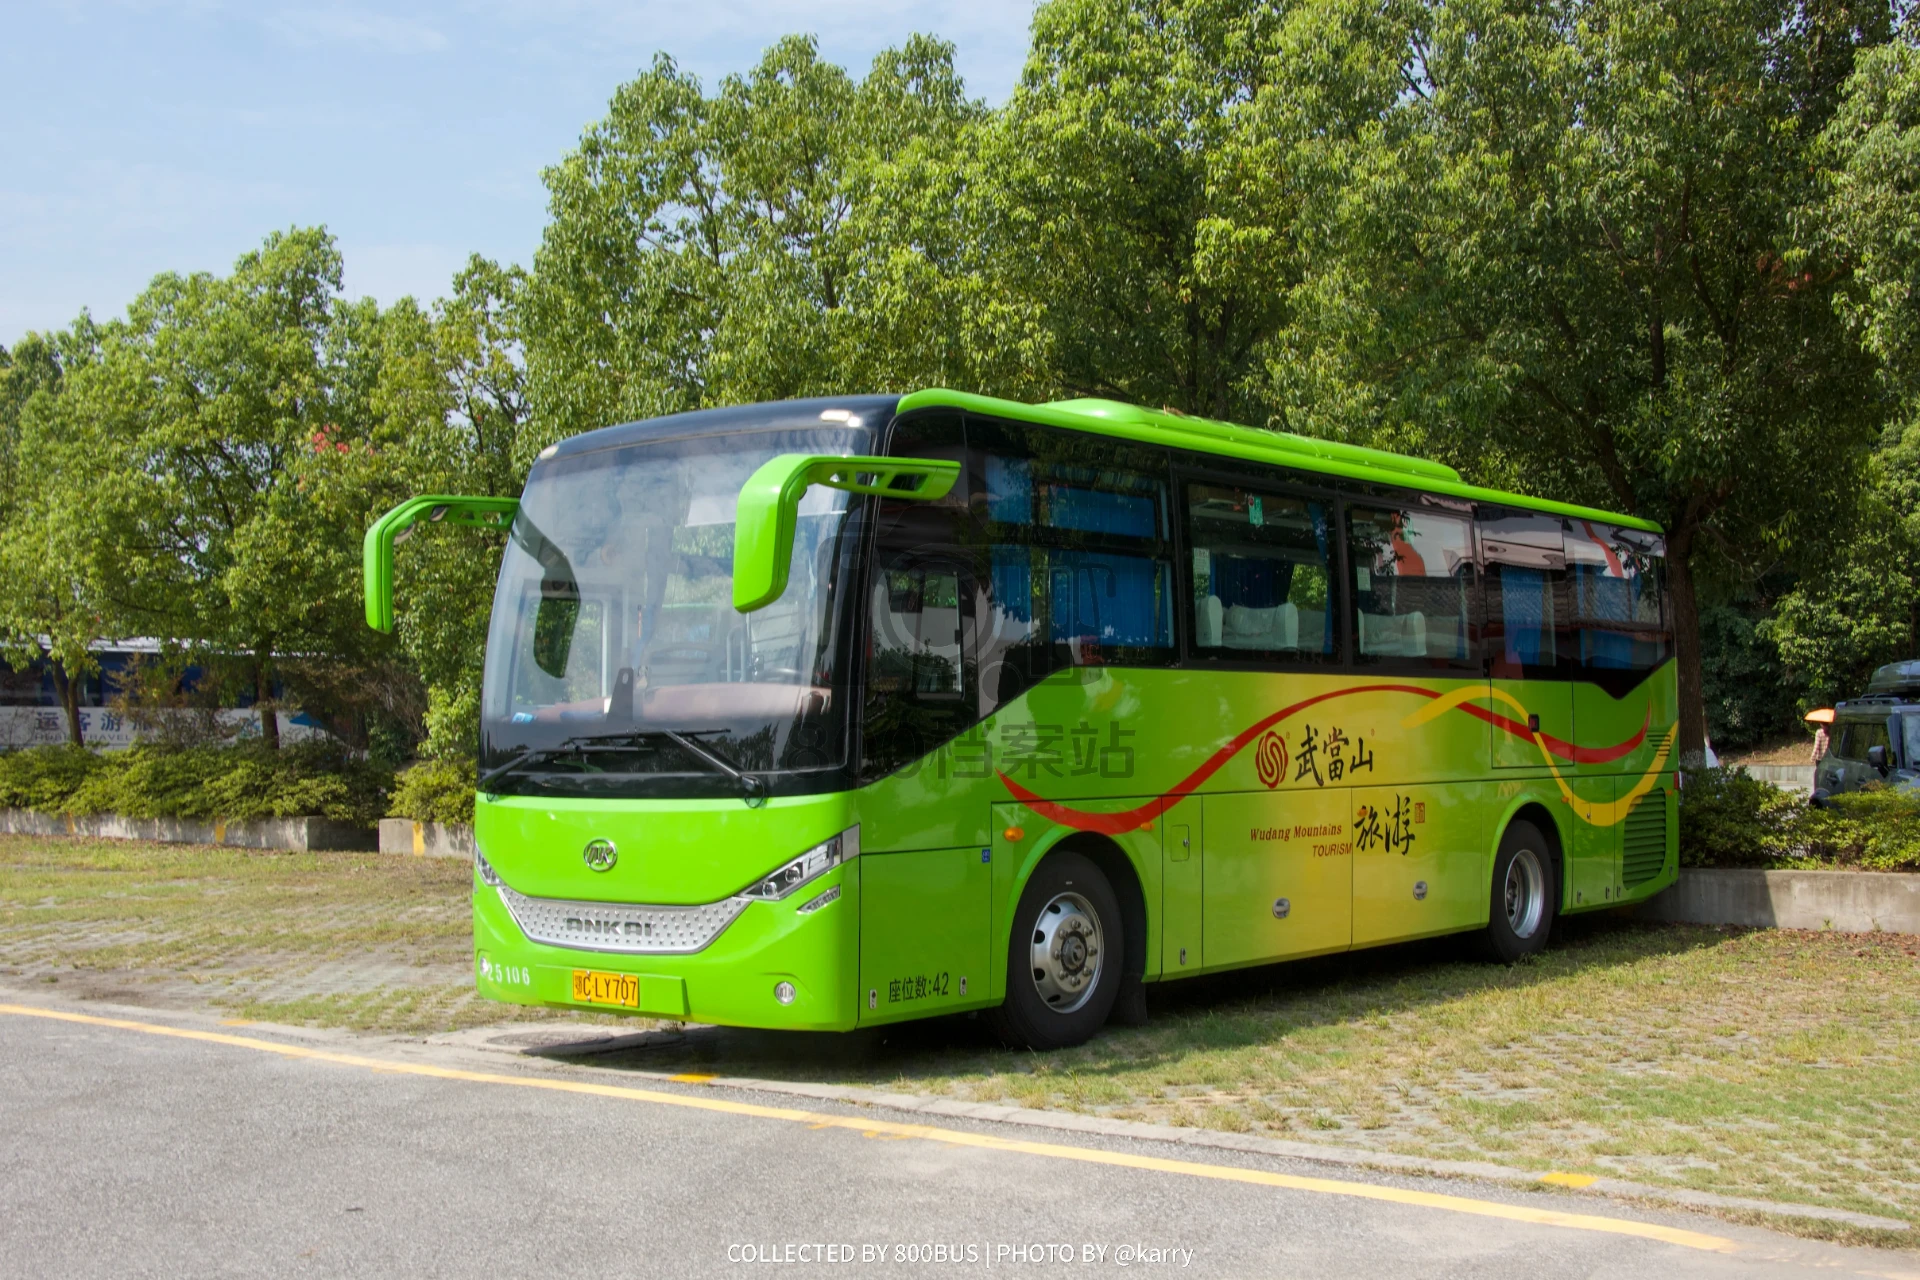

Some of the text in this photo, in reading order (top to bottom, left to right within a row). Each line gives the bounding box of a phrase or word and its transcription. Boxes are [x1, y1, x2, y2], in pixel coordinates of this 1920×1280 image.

[1250, 823, 1342, 842] Wudang Mountains
[1312, 843, 1353, 857] TOURISM
[566, 918, 652, 936] ANKAI
